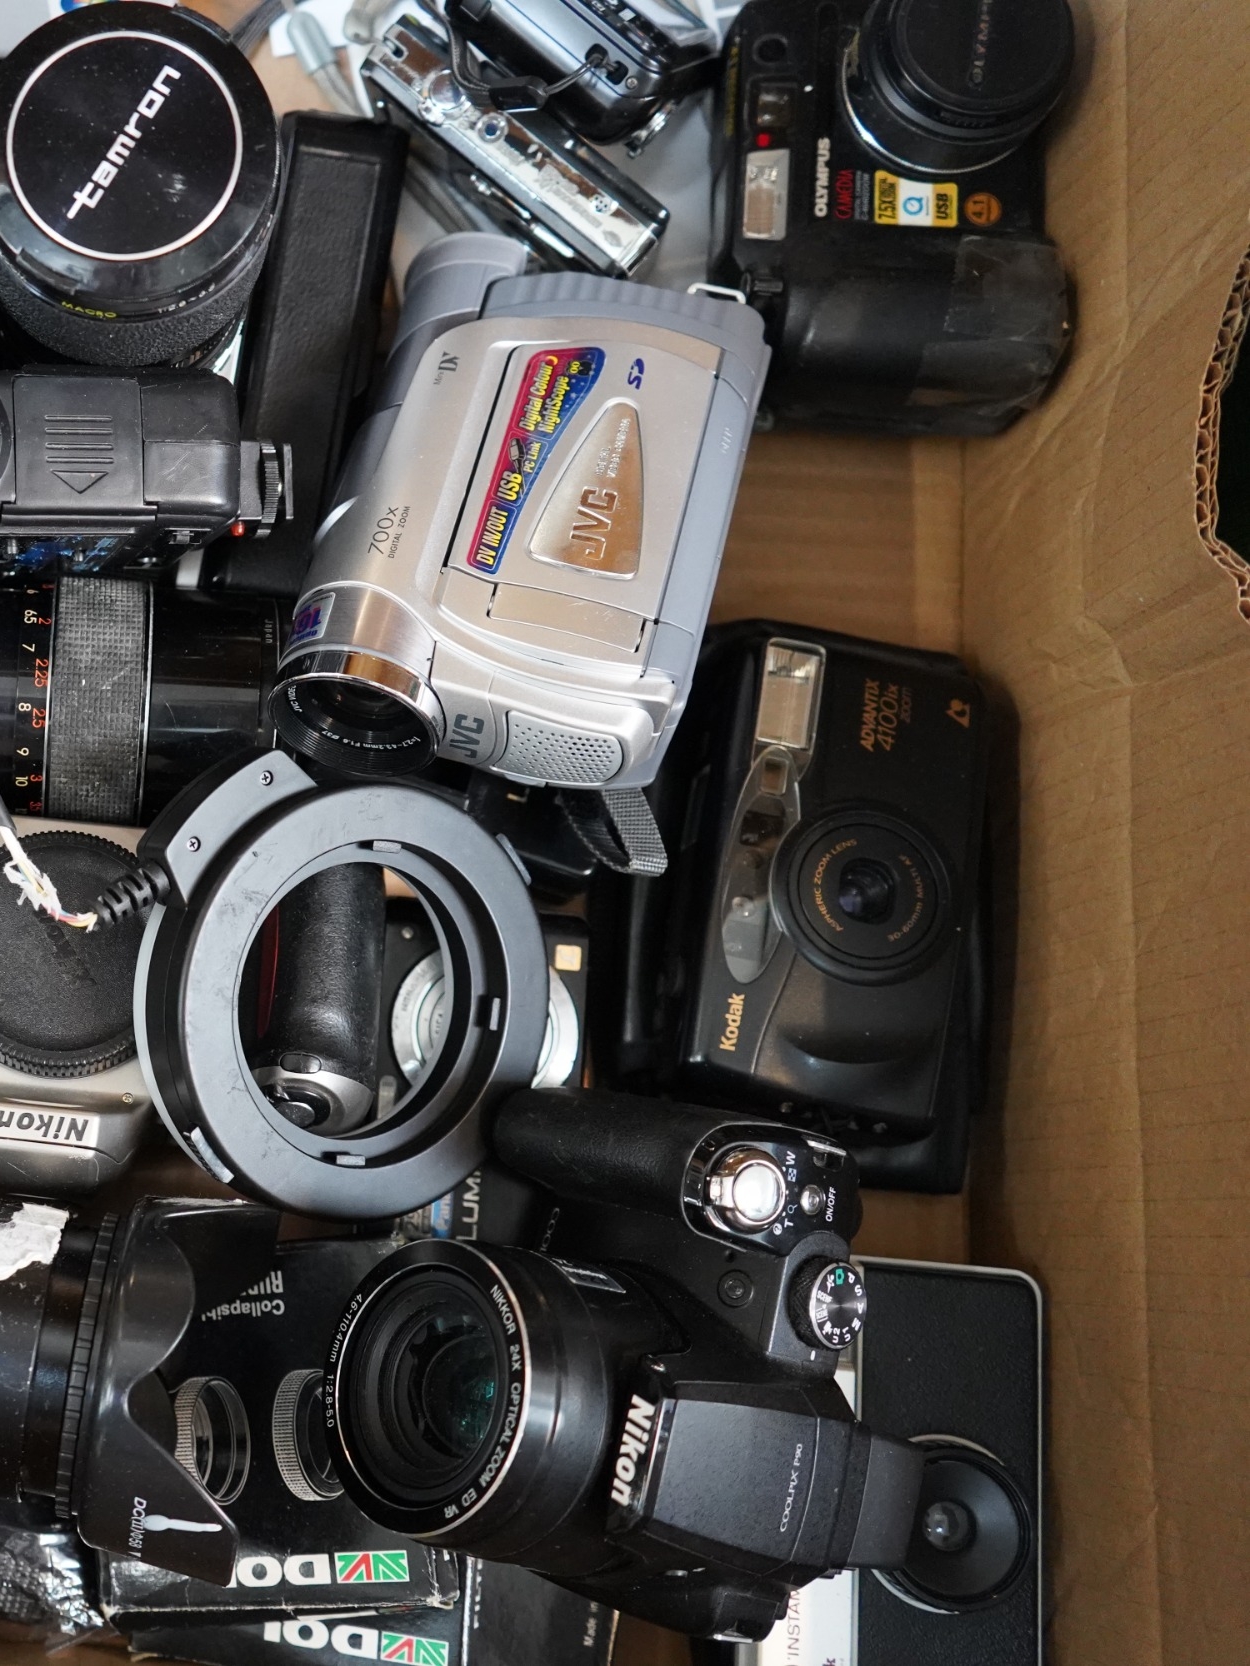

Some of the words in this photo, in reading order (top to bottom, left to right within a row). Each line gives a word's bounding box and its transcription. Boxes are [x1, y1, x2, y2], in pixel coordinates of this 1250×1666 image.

[66, 64, 182, 220] tamron
[813, 136, 831, 218] OLYMPUS
[834, 169, 855, 219] CAMEDIA
[935, 192, 949, 220] USB
[529, 361, 554, 399] Colour
[519, 399, 543, 432] Digital
[537, 375, 570, 434] NightScope
[523, 459, 535, 473] PC
[496, 470, 523, 501] USB
[387, 532, 403, 559] DIGITAL
[399, 504, 411, 529] ZOOM
[485, 505, 509, 549] IN/OUT
[569, 486, 618, 561] JVC
[476, 546, 496, 566] DV
[264, 618, 274, 644] Japan
[22, 643, 36, 652] 7
[34, 658, 50, 688] 2.25
[18, 702, 32, 712] 8
[31, 708, 47, 729] 2.5
[859, 677, 880, 752] ADVANTIX
[16, 747, 30, 756] 9
[449, 713, 485, 760] JVC
[14, 775, 29, 788] 10
[29, 774, 44, 783] 3
[830, 837, 859, 856] LENS
[813, 853, 832, 885] ZOOM
[813, 887, 845, 933] ASPHERIC
[718, 992, 746, 1052] Kodak
[785, 1150, 797, 1166] W
[824, 1185, 838, 1223] ON/OFF
[783, 1218, 795, 1229] T
[846, 1271, 856, 1284] P
[854, 1284, 863, 1297] S
[489, 1283, 516, 1336] NIKKOR
[851, 1316, 862, 1331] M
[856, 1302, 864, 1314] A
[508, 1343, 521, 1372] 24X
[498, 1382, 523, 1445] OPTICAL
[611, 1394, 656, 1507] Nikon
[477, 1445, 508, 1488] ZOOM
[461, 1486, 478, 1508] ED
[779, 1469, 799, 1532] COOLPIX
[793, 1443, 803, 1466] P90
[442, 1505, 460, 1520] VR
[263, 1620, 379, 1660] DOI
